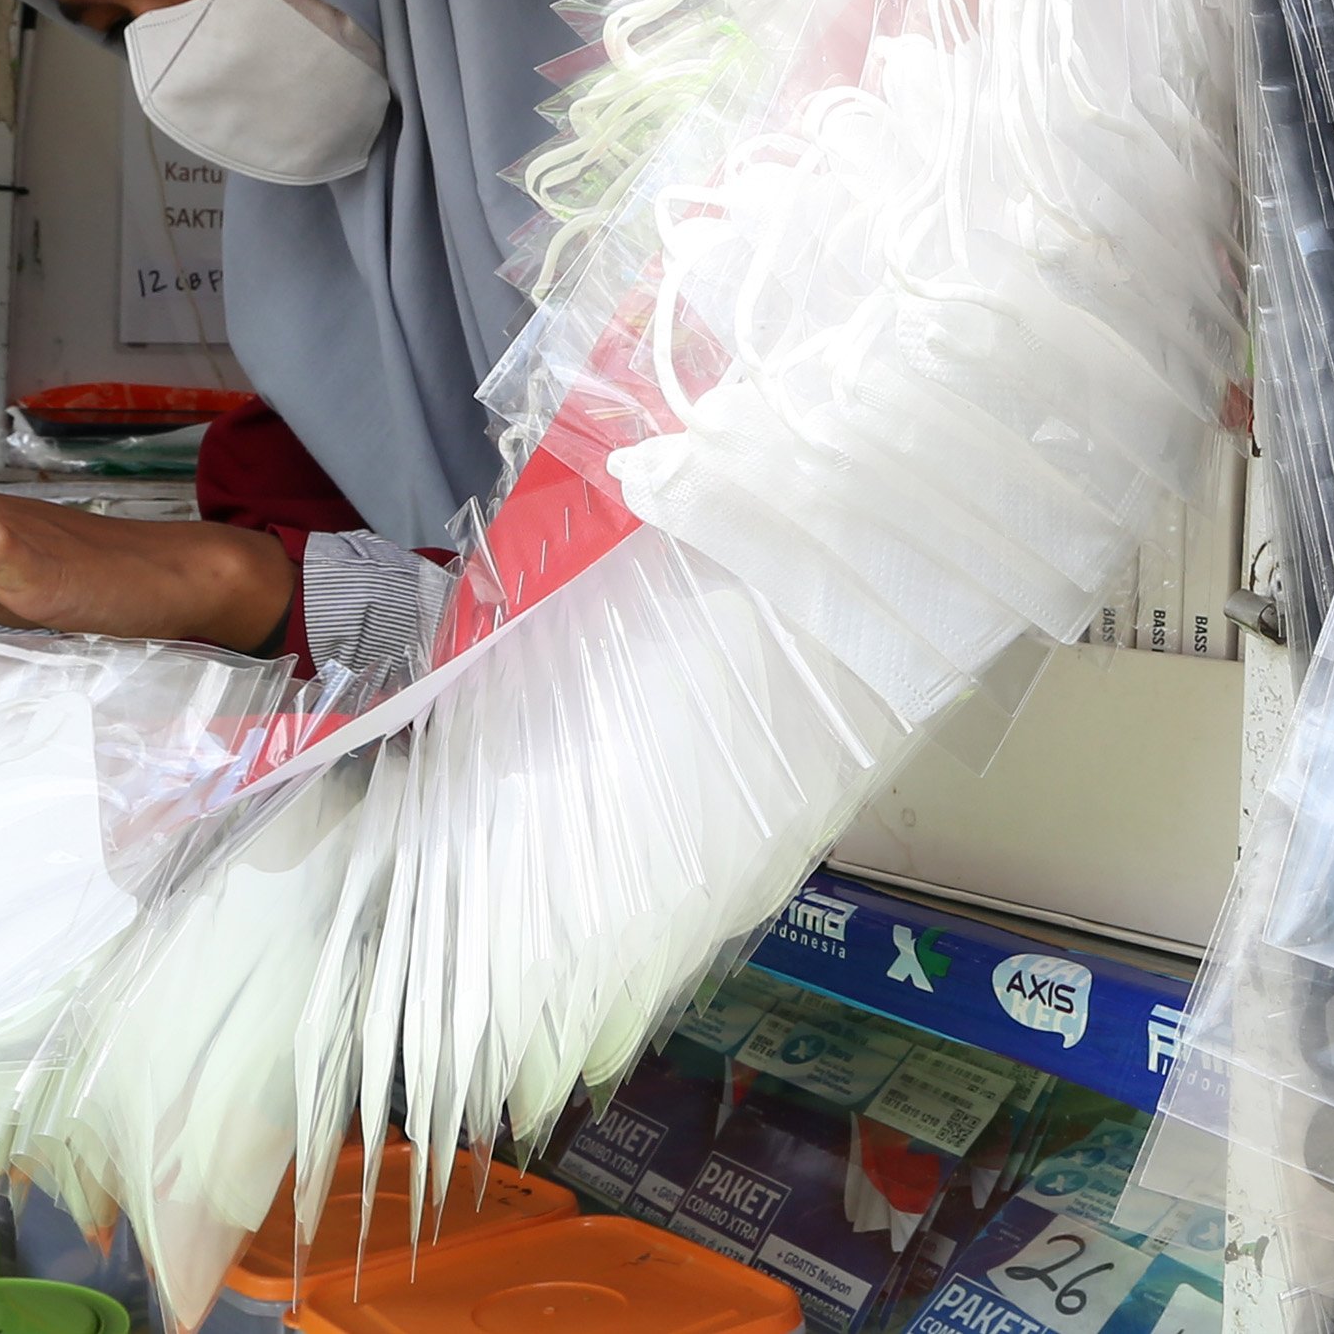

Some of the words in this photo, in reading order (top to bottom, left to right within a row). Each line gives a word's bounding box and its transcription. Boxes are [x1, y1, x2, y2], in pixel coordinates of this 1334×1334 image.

[164, 162, 223, 184] Kartu
[1152, 609, 1166, 647] BASS
[1194, 615, 1209, 654] BASS
[768, 922, 846, 959] ndonesia
[1006, 970, 1076, 1014] AXIS
[575, 1134, 612, 1164] COMBO
[609, 1155, 639, 1179] XTRA
[697, 1162, 781, 1220] PAKET
[684, 1194, 729, 1227] COMBO
[727, 1217, 760, 1244] XTRA
[783, 1251, 819, 1278] GRATIS
[817, 1268, 852, 1295] Nelpon
[1004, 1234, 1115, 1316] 26
